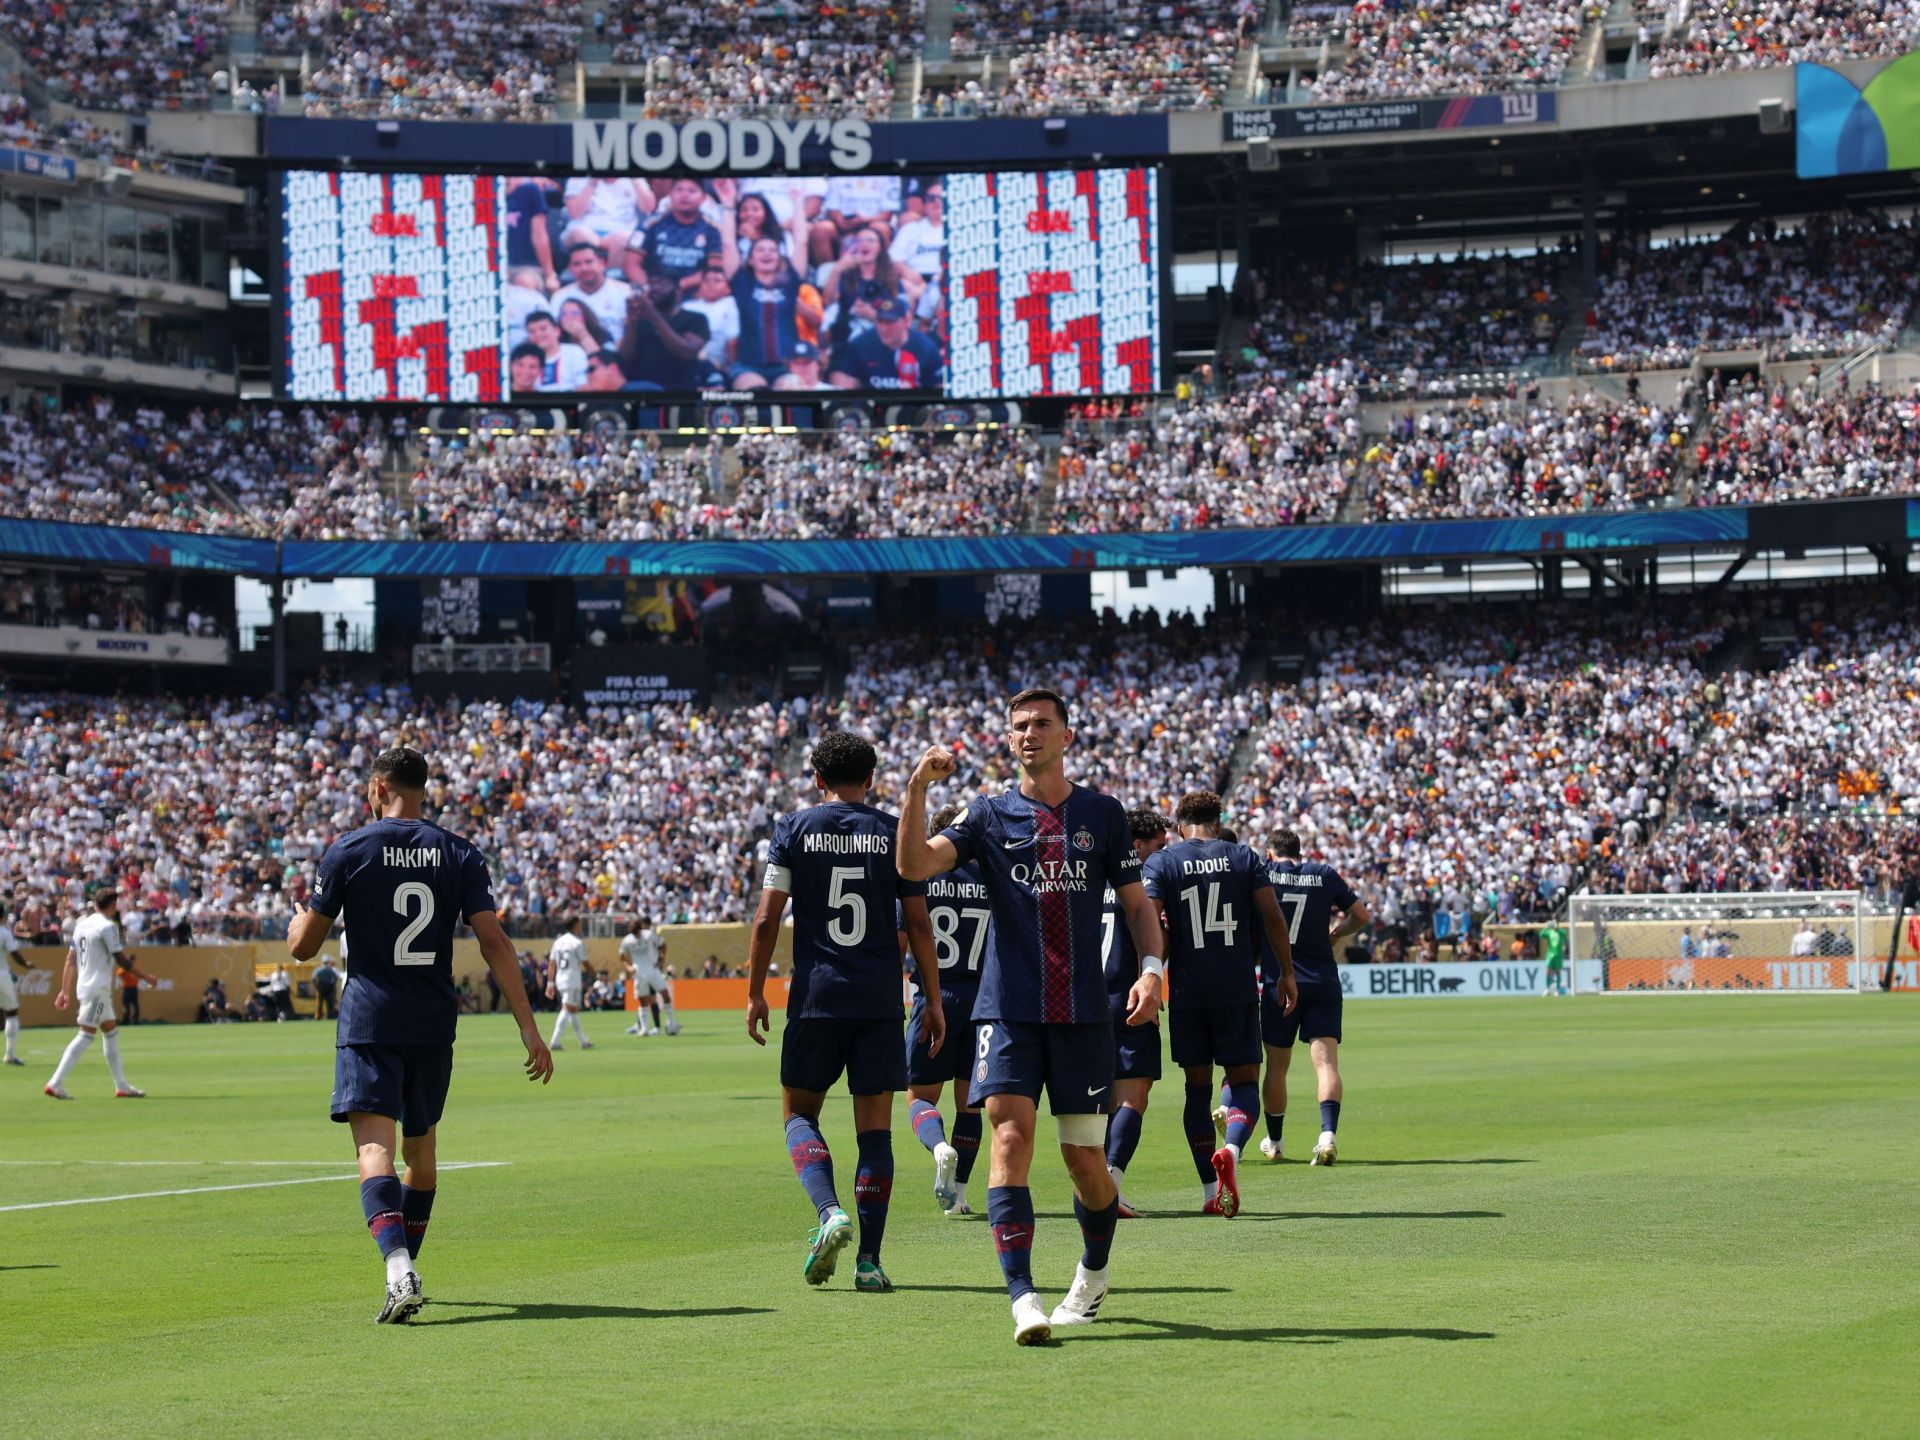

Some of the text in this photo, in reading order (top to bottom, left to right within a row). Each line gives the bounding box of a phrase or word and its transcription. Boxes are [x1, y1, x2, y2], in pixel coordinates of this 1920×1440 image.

[572, 118, 872, 171] MOODY'S
[383, 846, 441, 868] HAKIMI
[803, 833, 889, 854] MARQUINHOS
[1010, 860, 1088, 886] QATAR
[1183, 855, 1231, 876] D.DOUÉ
[926, 879, 988, 899] JOÃO NEVE
[1031, 879, 1087, 894] AIRWAYS
[828, 866, 867, 947] 5
[1180, 881, 1239, 950] 14
[1281, 893, 1308, 945] 7
[393, 881, 437, 966] 2
[929, 906, 992, 970] 87
[1369, 969, 1436, 994] BEHR
[1479, 968, 1540, 992] ONLY
[1766, 961, 1832, 989] THE
[979, 1024, 993, 1059] 8
